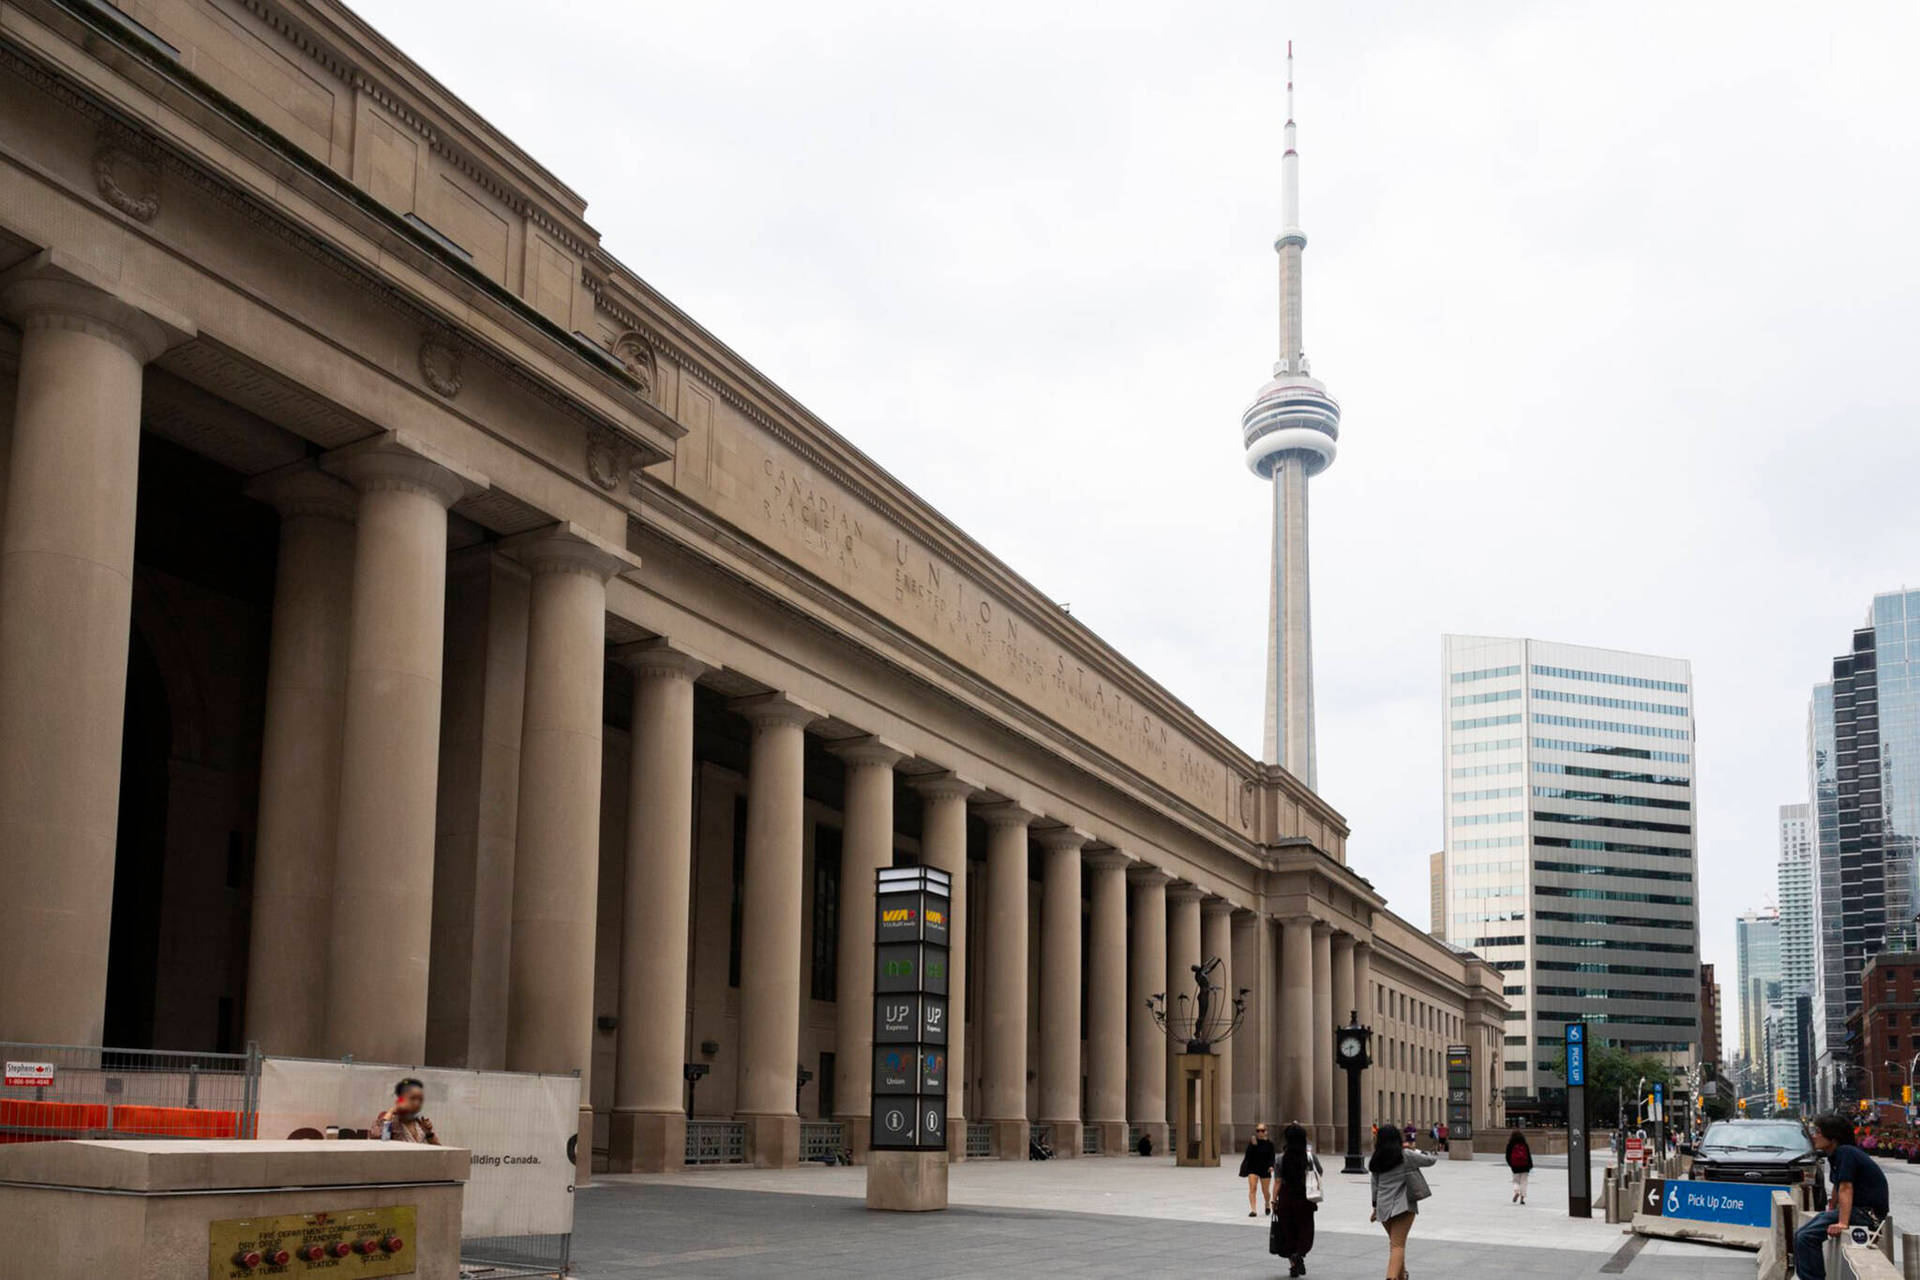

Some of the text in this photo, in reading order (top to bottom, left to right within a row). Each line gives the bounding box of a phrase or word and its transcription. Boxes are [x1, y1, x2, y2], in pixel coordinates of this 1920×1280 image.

[764, 459, 863, 538] CANADIAN
[896, 538, 1016, 640] UNION
[1057, 654, 1168, 745] STATION
[883, 909, 909, 922] VIA
[886, 1005, 909, 1022] UP
[927, 1006, 942, 1024] UP
[1572, 1047, 1580, 1082] PICK UP
[503, 1155, 542, 1165] Canada.
[1687, 1193, 1745, 1211] Pick Up Zone
